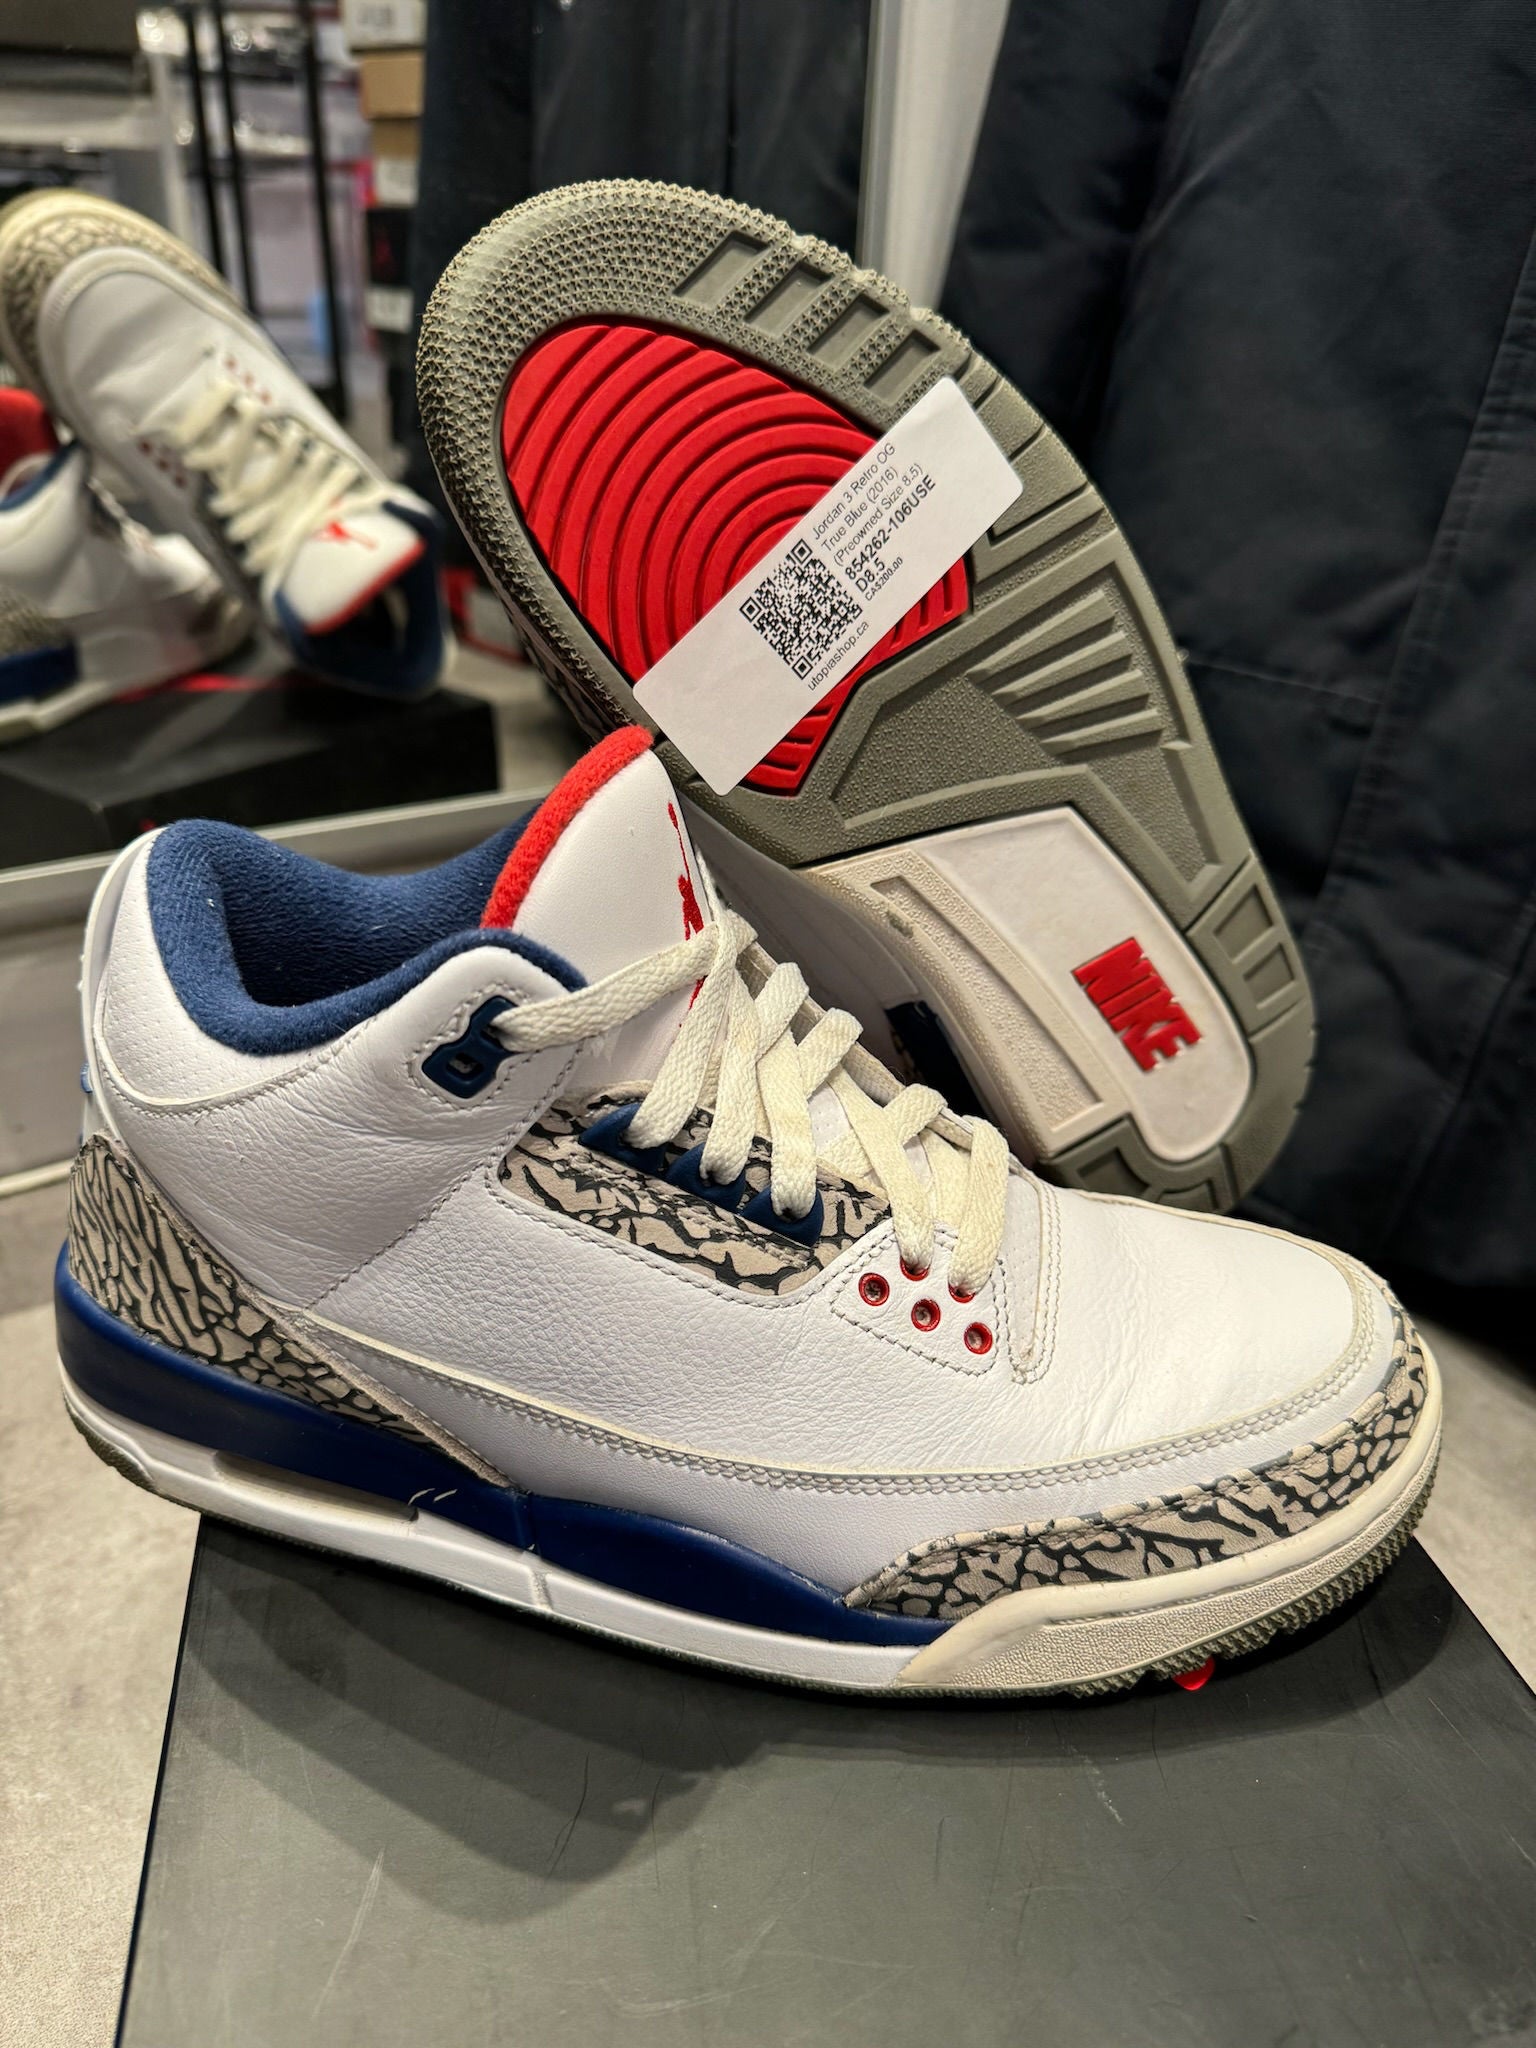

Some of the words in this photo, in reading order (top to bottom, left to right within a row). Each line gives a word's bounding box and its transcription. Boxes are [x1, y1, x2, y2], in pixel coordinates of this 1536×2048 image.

[813, 502, 845, 540] Jordan
[843, 491, 853, 503] 3
[850, 464, 878, 494] Retro
[876, 442, 896, 464] OG
[821, 527, 847, 552] True
[844, 502, 868, 527] Blue
[866, 466, 898, 504] (2016)
[833, 509, 883, 567] (Preowned
[881, 485, 904, 510] Size
[902, 463, 924, 487] 8.5)
[845, 474, 936, 580] 854262-106USE
[855, 557, 885, 592] D8.5
[865, 556, 904, 601] CA$200.00
[807, 621, 869, 691] utopiashop.ca
[1071, 936, 1202, 1072] NIKE
